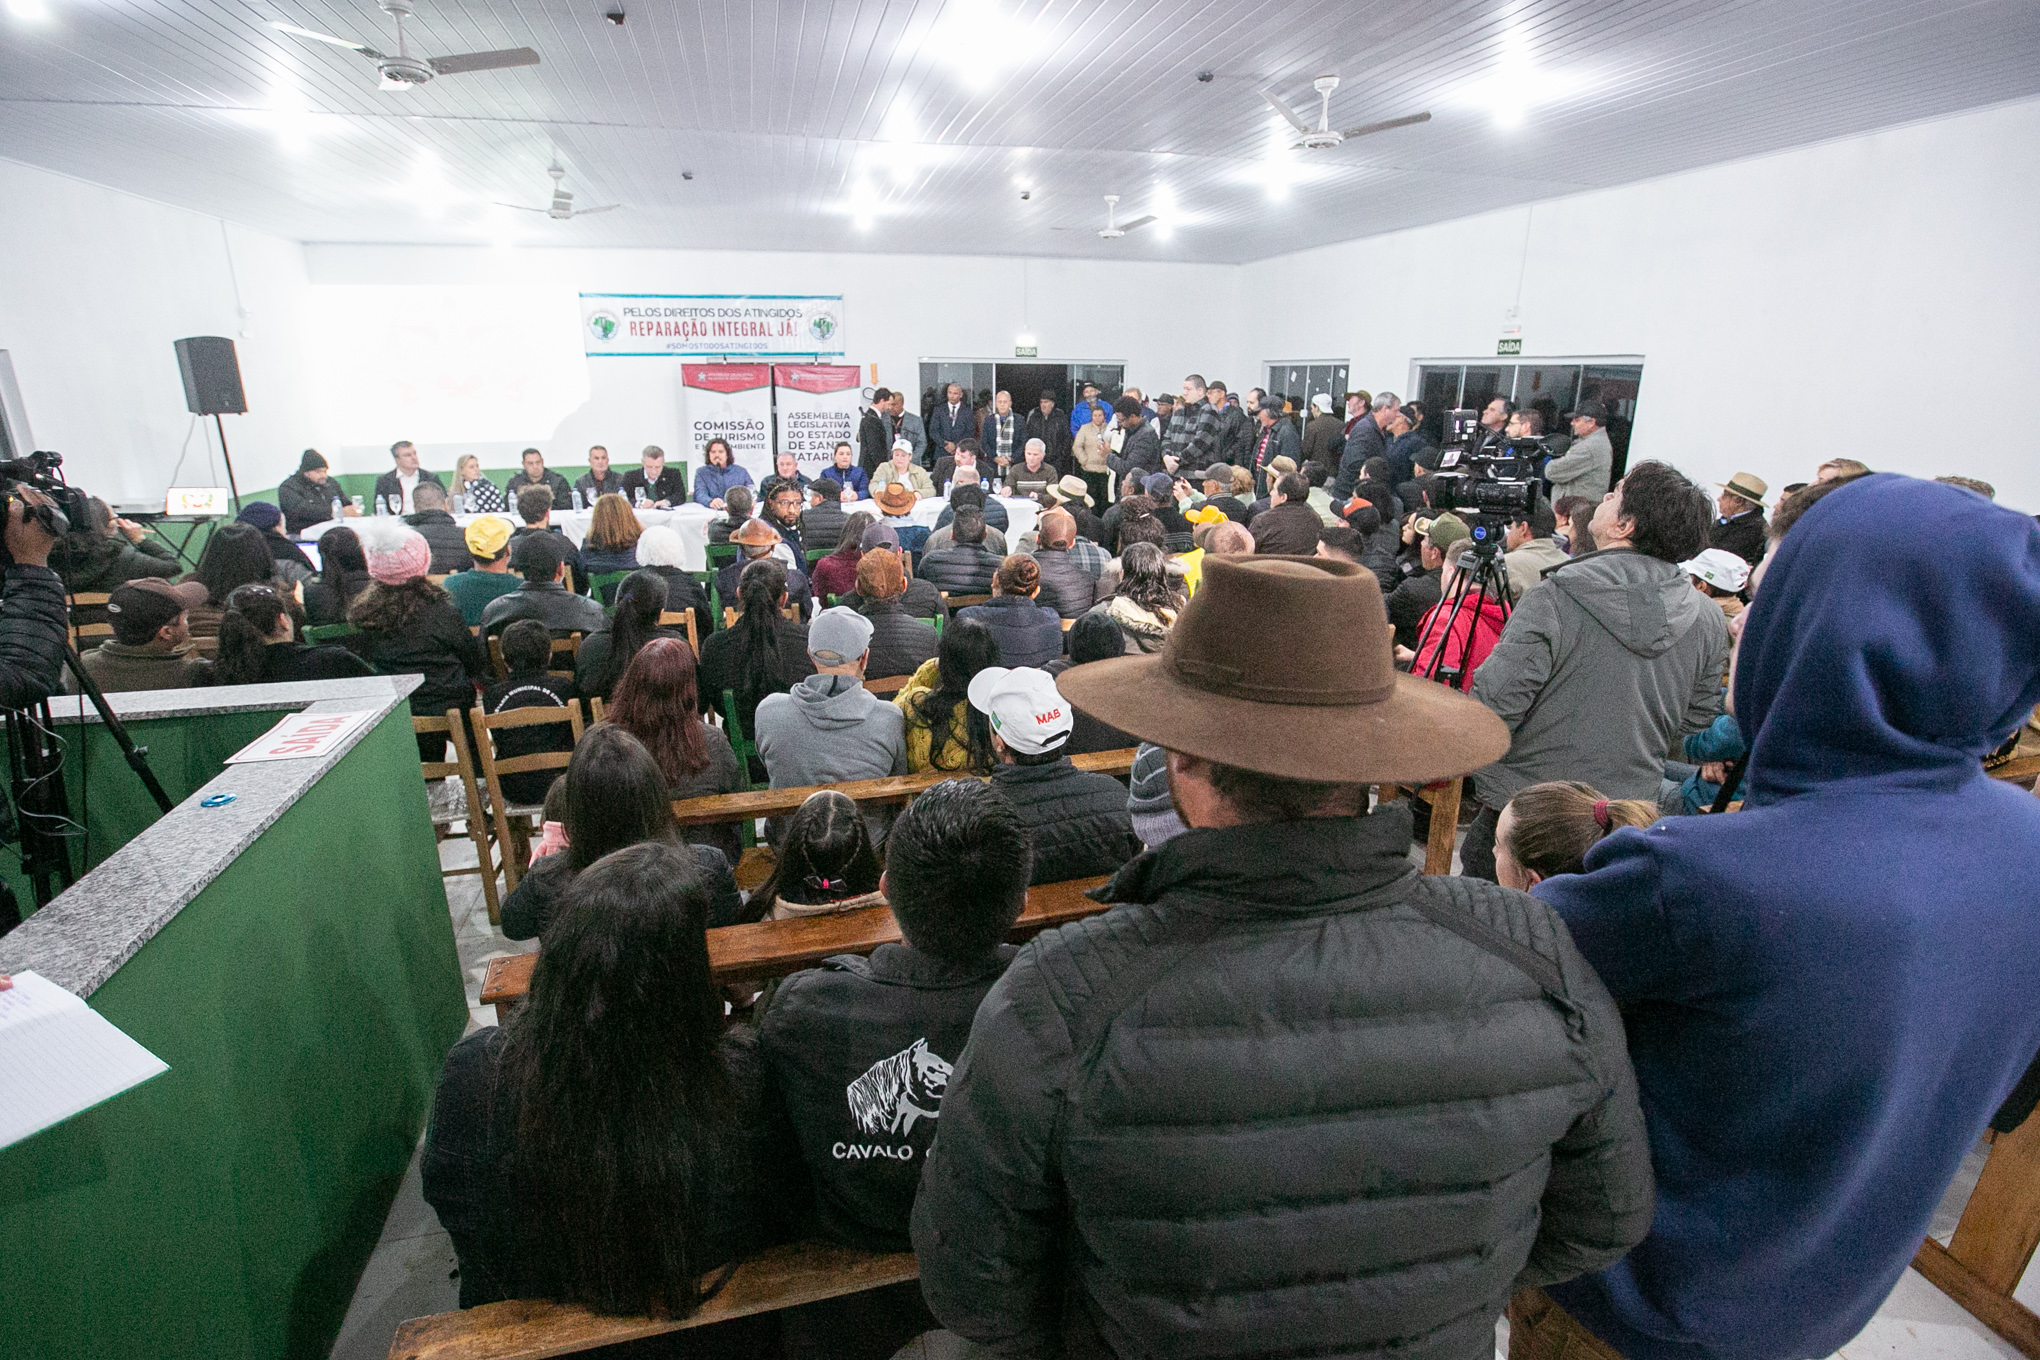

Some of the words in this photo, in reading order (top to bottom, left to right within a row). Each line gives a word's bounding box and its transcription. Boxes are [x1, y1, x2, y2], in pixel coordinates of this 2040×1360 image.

[623, 307, 661, 317] PELOS
[664, 307, 715, 317] DIREITOS
[717, 308, 741, 318] DOS
[744, 308, 803, 318] ATINGIDOS
[629, 318, 707, 341] REPARAÇÃO
[712, 321, 773, 337] INTEGRAL
[777, 318, 798, 337] JÁ!
[1498, 340, 1520, 353] SAÍDA
[788, 411, 850, 420] ASSEMBLEIA
[694, 418, 765, 431] COMISSÃO
[788, 421, 850, 429] LEGISLATIVA
[694, 433, 709, 441] DE
[713, 433, 765, 441] TURISMO
[788, 430, 805, 439] DO
[808, 430, 851, 439] ESTADO
[788, 441, 805, 450] DE
[809, 441, 840, 450] SAN
[793, 452, 834, 461] ATARI
[508, 685, 541, 696] MUNICIPAL
[1035, 708, 1062, 725] MAB
[269, 715, 352, 755] SAÍDA
[832, 1142, 914, 1160] CAVALO
